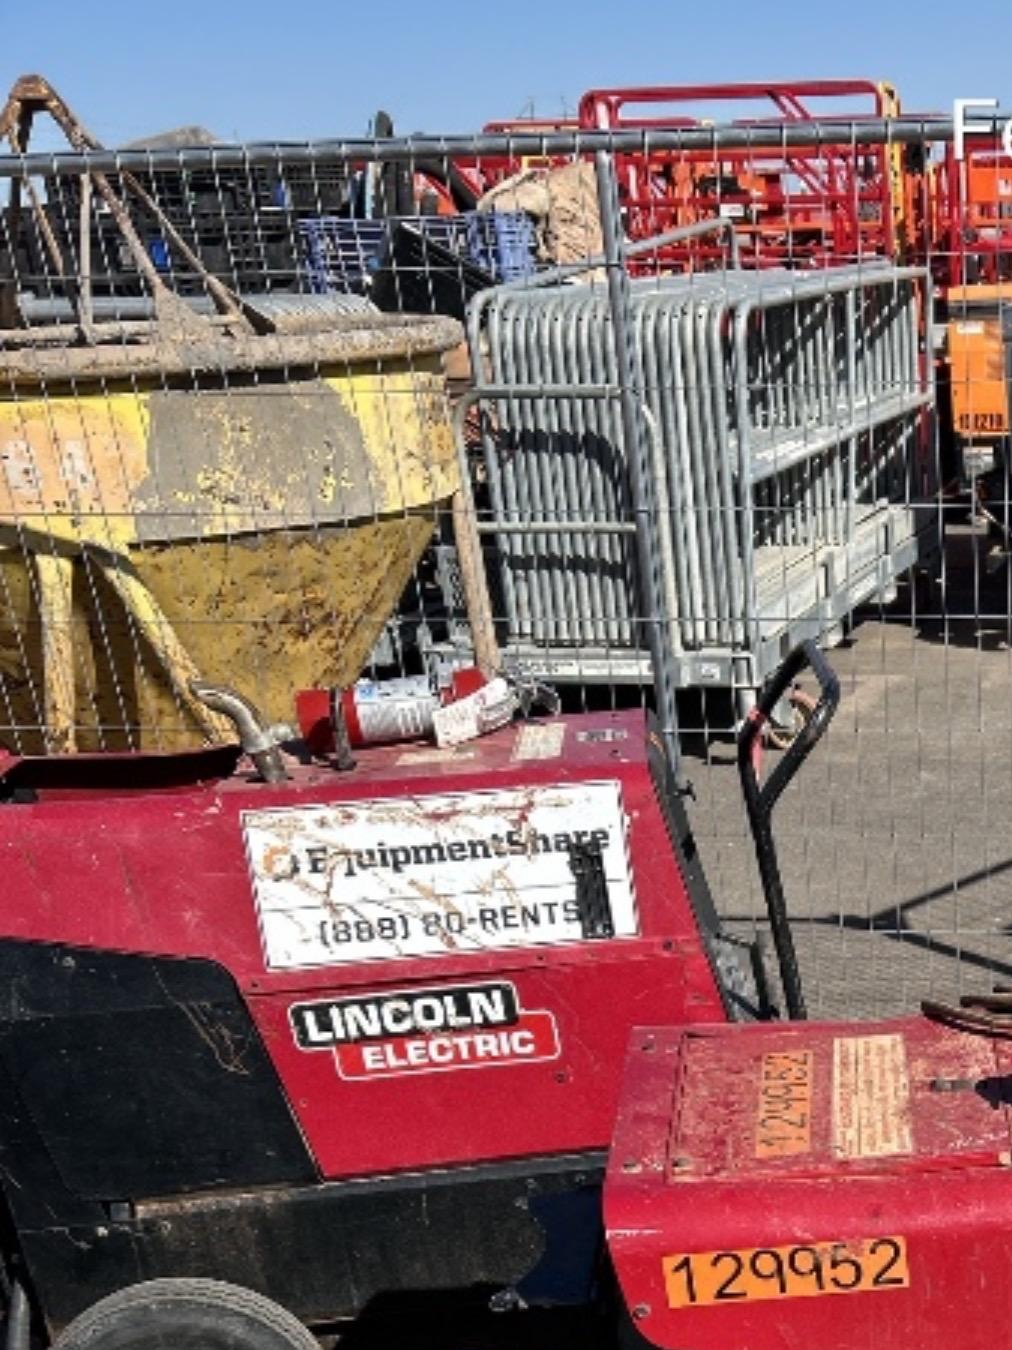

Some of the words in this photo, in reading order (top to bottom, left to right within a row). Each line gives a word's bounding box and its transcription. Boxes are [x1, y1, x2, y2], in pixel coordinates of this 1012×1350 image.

[305, 827, 609, 878] EquipmentShare
[319, 914, 410, 947] (888)
[303, 989, 507, 1043] LINCOLN
[361, 1030, 536, 1071] ELECTRIC
[671, 1238, 904, 1303] 129952
